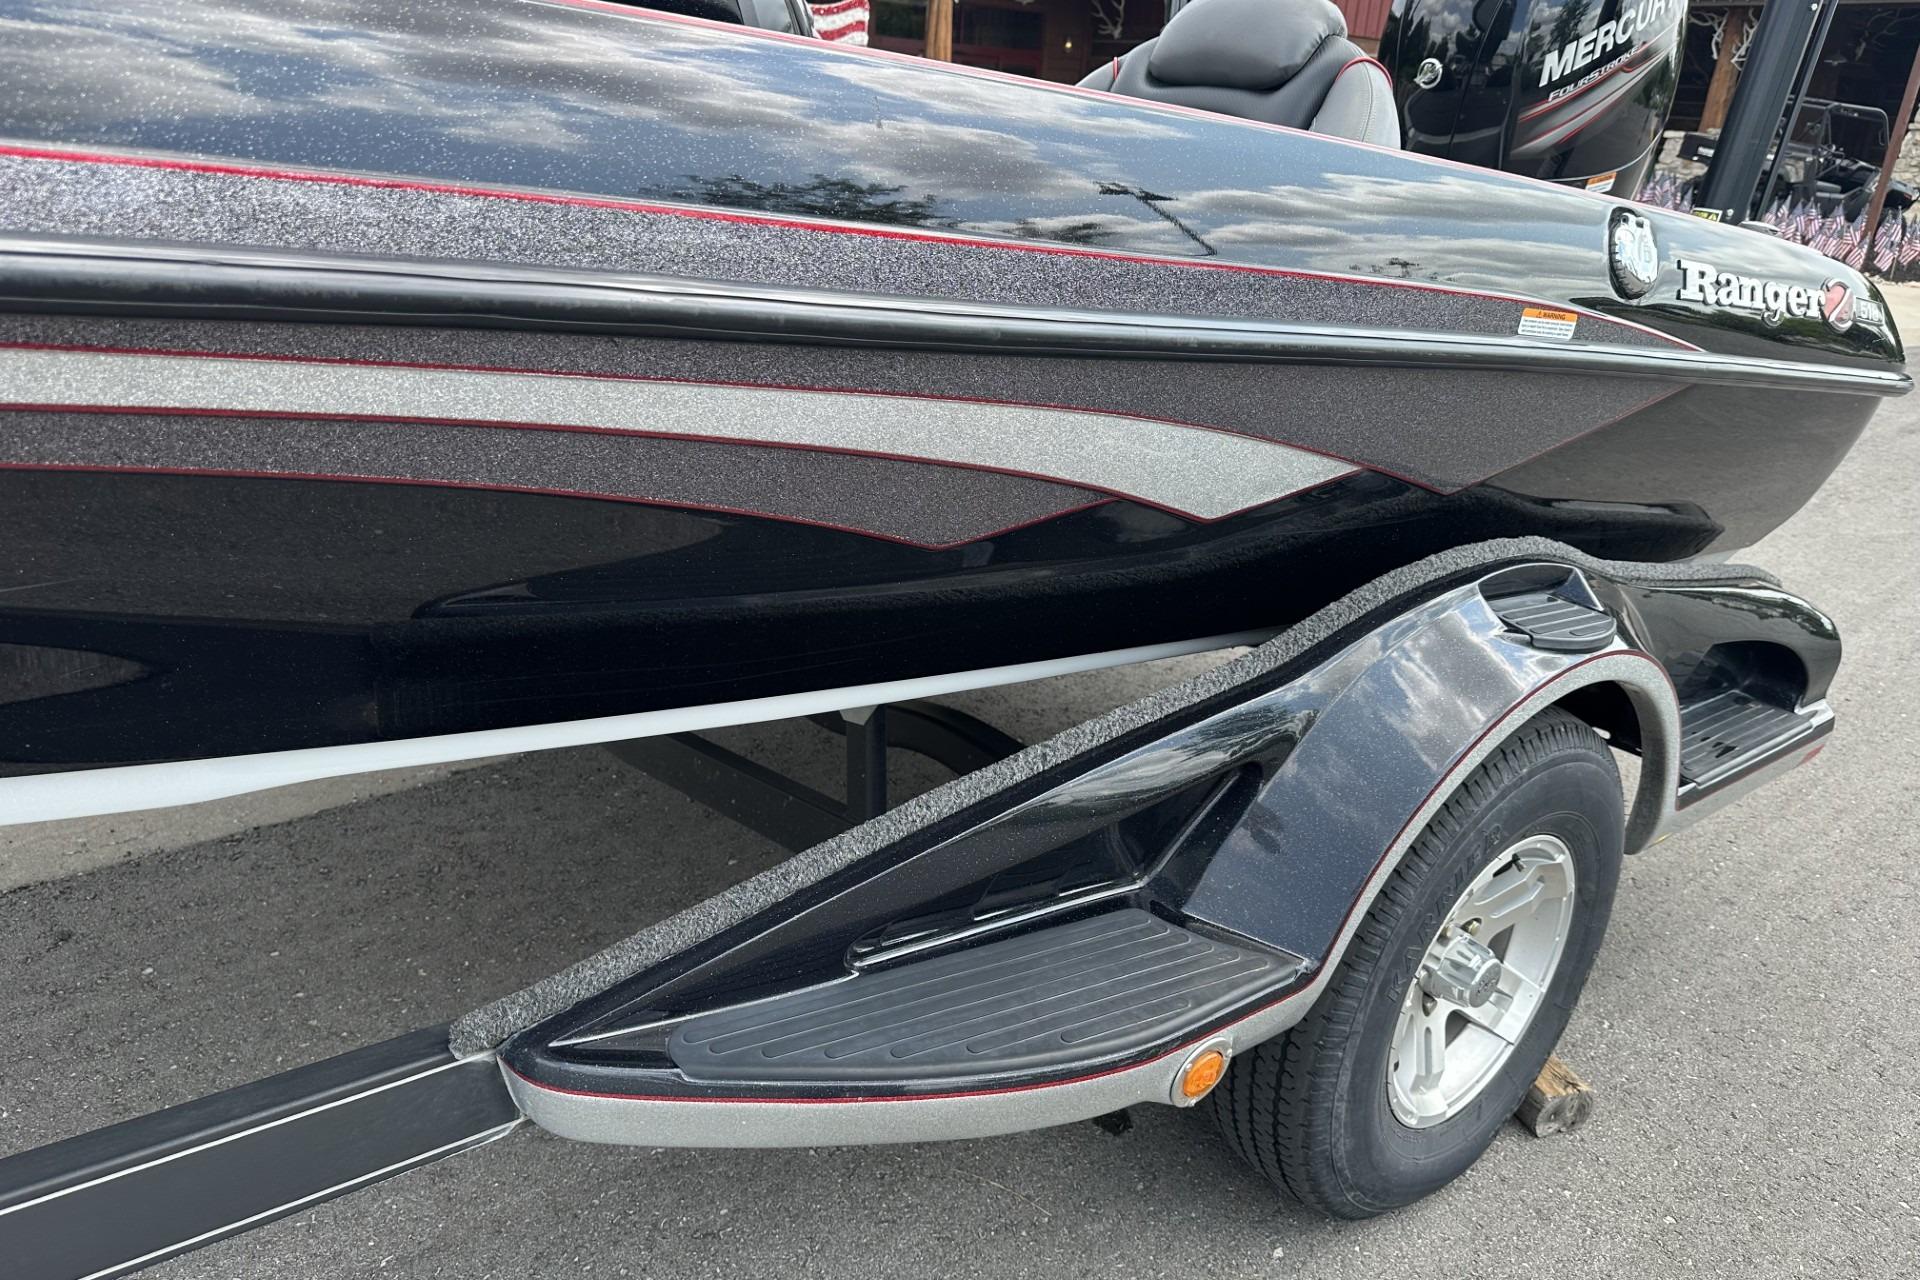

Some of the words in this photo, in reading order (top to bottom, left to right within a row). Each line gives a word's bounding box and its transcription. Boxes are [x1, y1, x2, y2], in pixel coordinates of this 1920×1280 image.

[1539, 0, 1675, 87] MERCUR
[1548, 45, 1640, 101] FOURSTROKE
[1542, 311, 1567, 320] WARNING
[1677, 259, 1826, 327] Ranger
